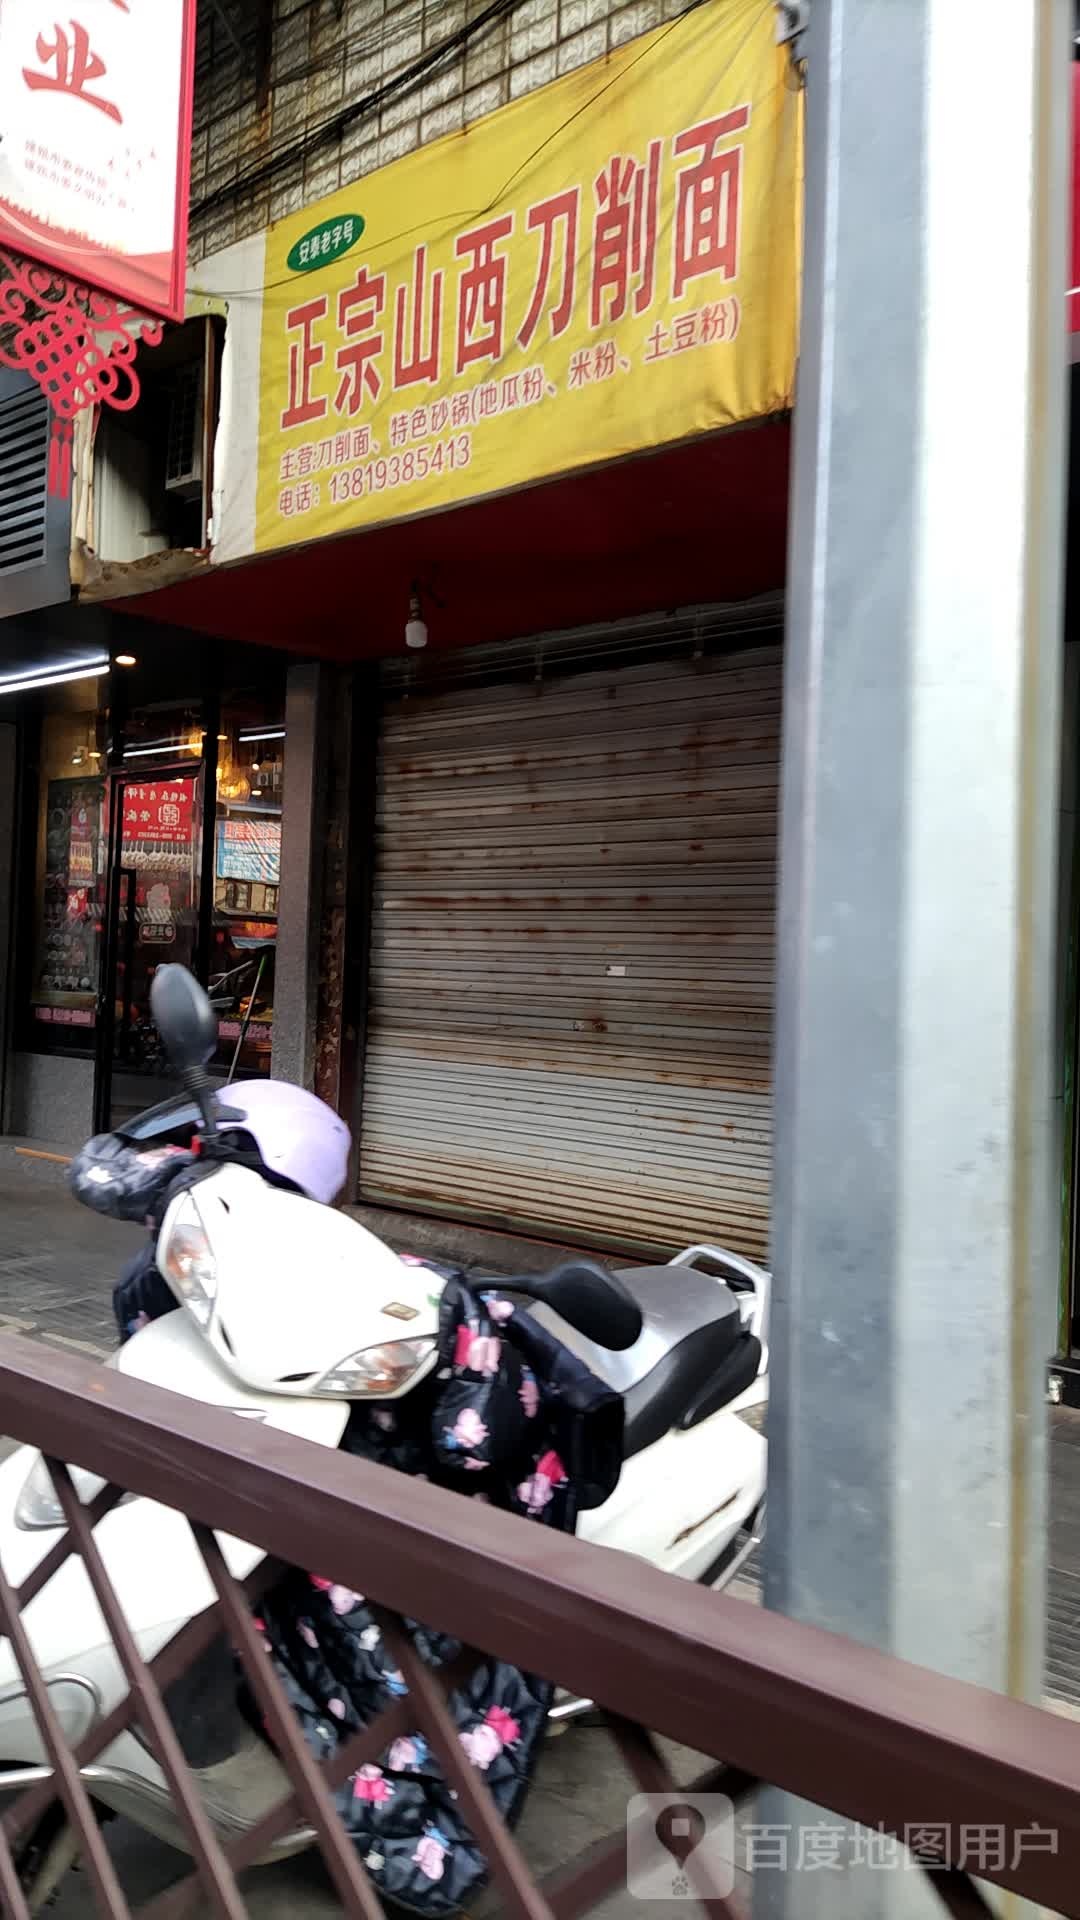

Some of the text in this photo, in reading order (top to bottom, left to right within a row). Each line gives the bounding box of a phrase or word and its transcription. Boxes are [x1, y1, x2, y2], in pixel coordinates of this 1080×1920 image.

[22, 18, 123, 125] 业
[280, 104, 751, 430] 正宗山西刀削面
[298, 218, 354, 266] 安泰老字号
